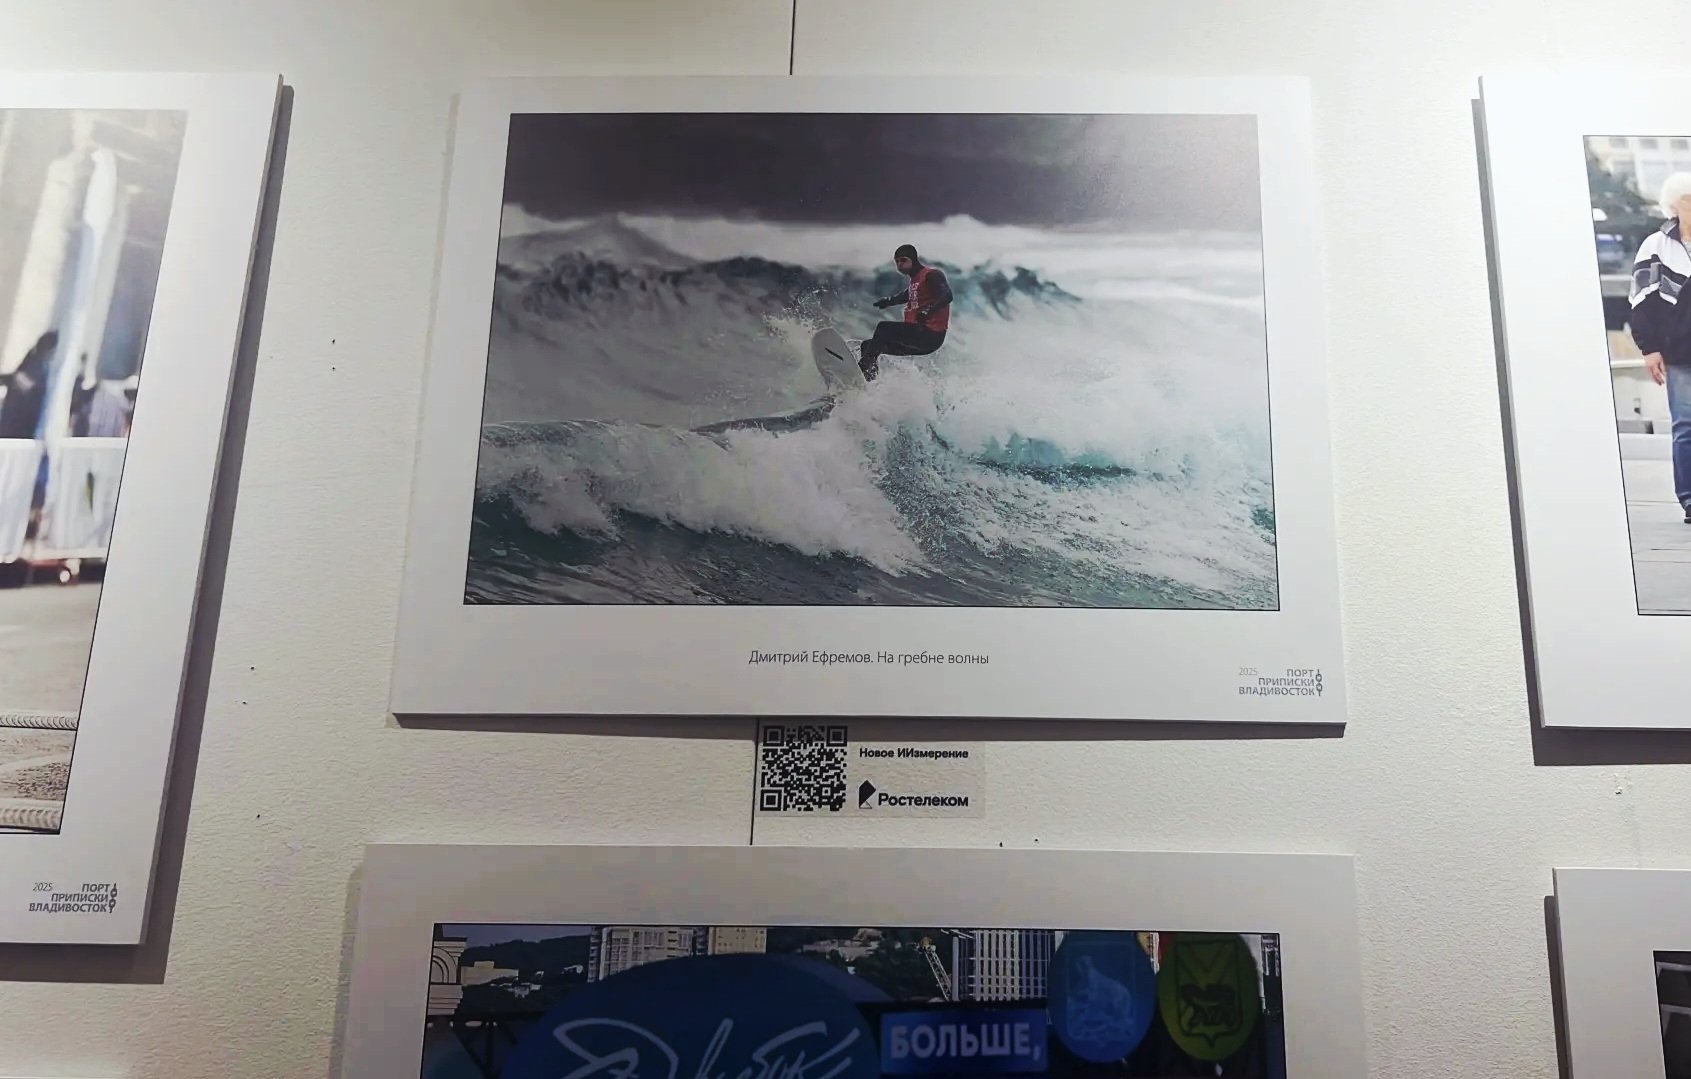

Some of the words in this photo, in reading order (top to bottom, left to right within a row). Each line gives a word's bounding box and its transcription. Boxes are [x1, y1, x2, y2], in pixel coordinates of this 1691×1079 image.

[749, 650, 808, 666] Дмитрий
[812, 651, 874, 666] Ефремов.
[877, 651, 894, 663] На
[898, 651, 944, 667] гребне
[948, 653, 989, 664] волны
[1239, 667, 1258, 676] 2025
[1286, 668, 1315, 678] ПОРТ
[1258, 677, 1315, 686] ПРИПИСКИ
[1238, 686, 1315, 696] ВЛАДИВОСТОК
[859, 747, 895, 758] Новое
[897, 747, 969, 760] ИИзмерение
[878, 792, 969, 807] Ростелеком
[32, 882, 54, 892] 2025
[81, 883, 111, 893] ПОРТ
[51, 893, 109, 903] ПРИПИСКИ
[28, 902, 108, 913] ВЛАДИВОСТОК
[890, 1022, 1041, 1062] БОЛЬШЕ,
